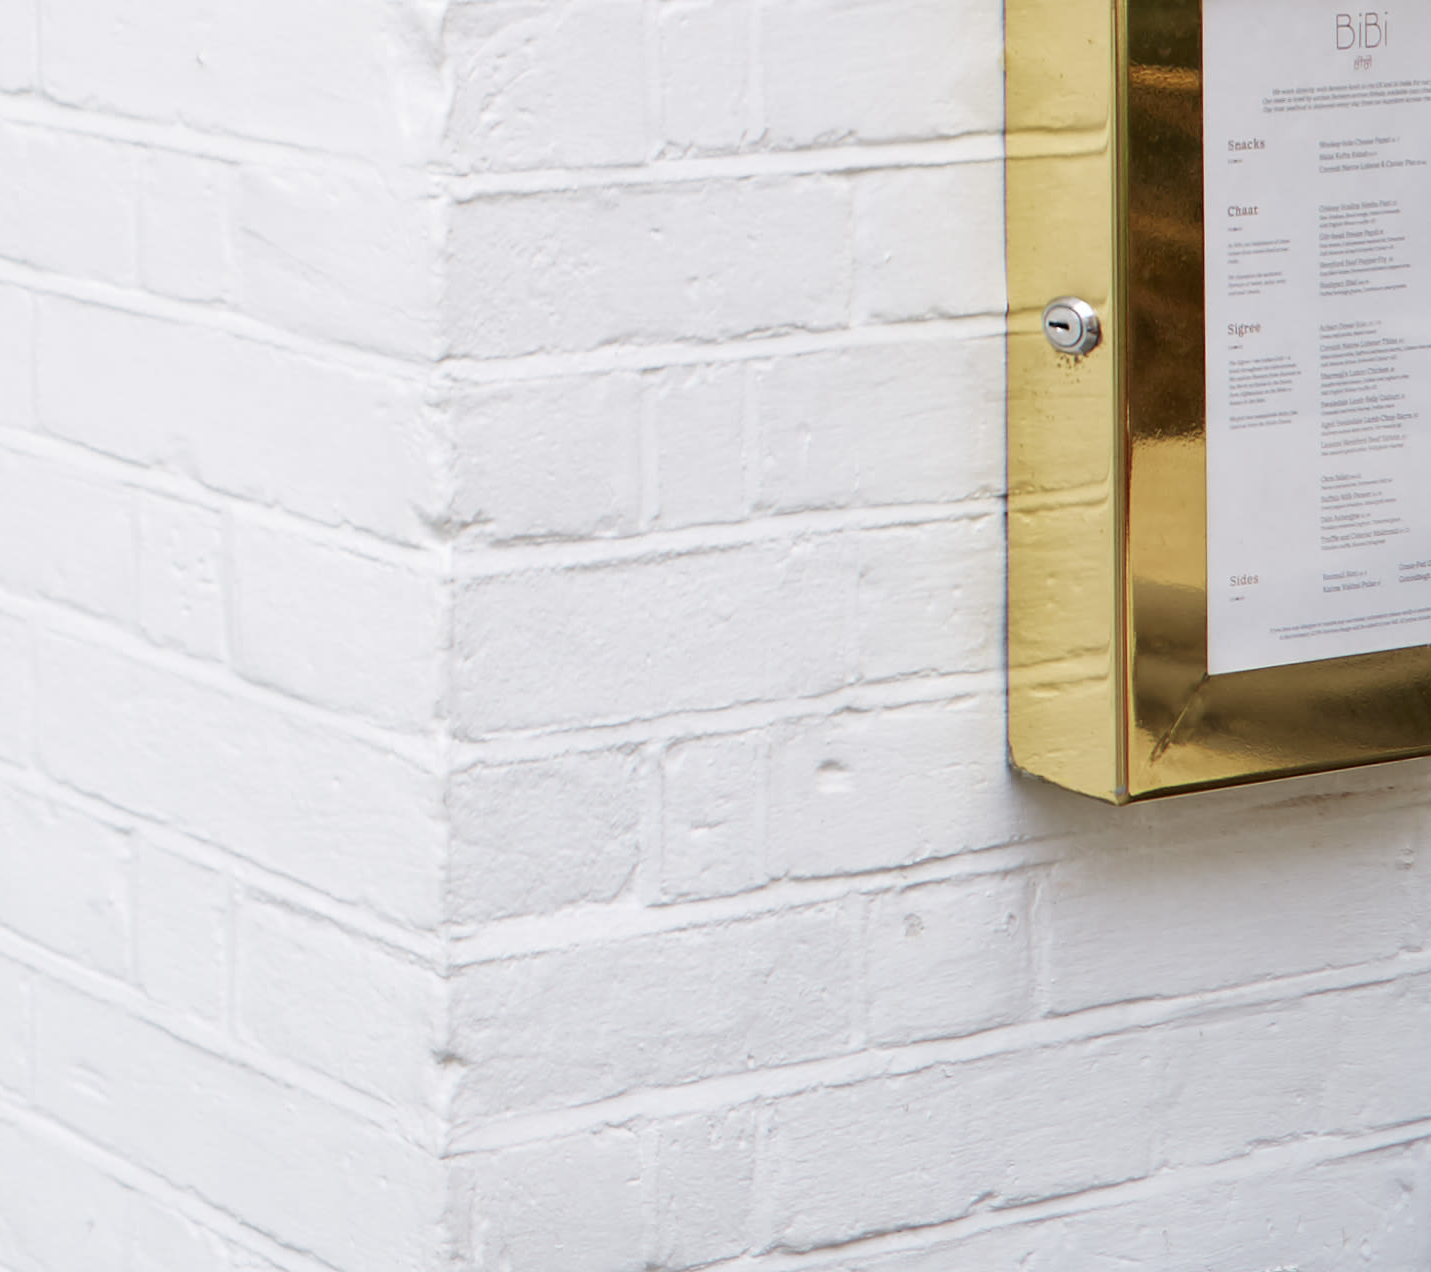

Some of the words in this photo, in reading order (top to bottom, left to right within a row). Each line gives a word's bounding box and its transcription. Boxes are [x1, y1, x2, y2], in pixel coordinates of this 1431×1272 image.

[1335, 11, 1388, 51] BiBi
[1227, 137, 1266, 152] Snacks
[1227, 205, 1259, 218] Chaat
[1227, 323, 1261, 338] Sigree
[1229, 574, 1259, 587] Sides
